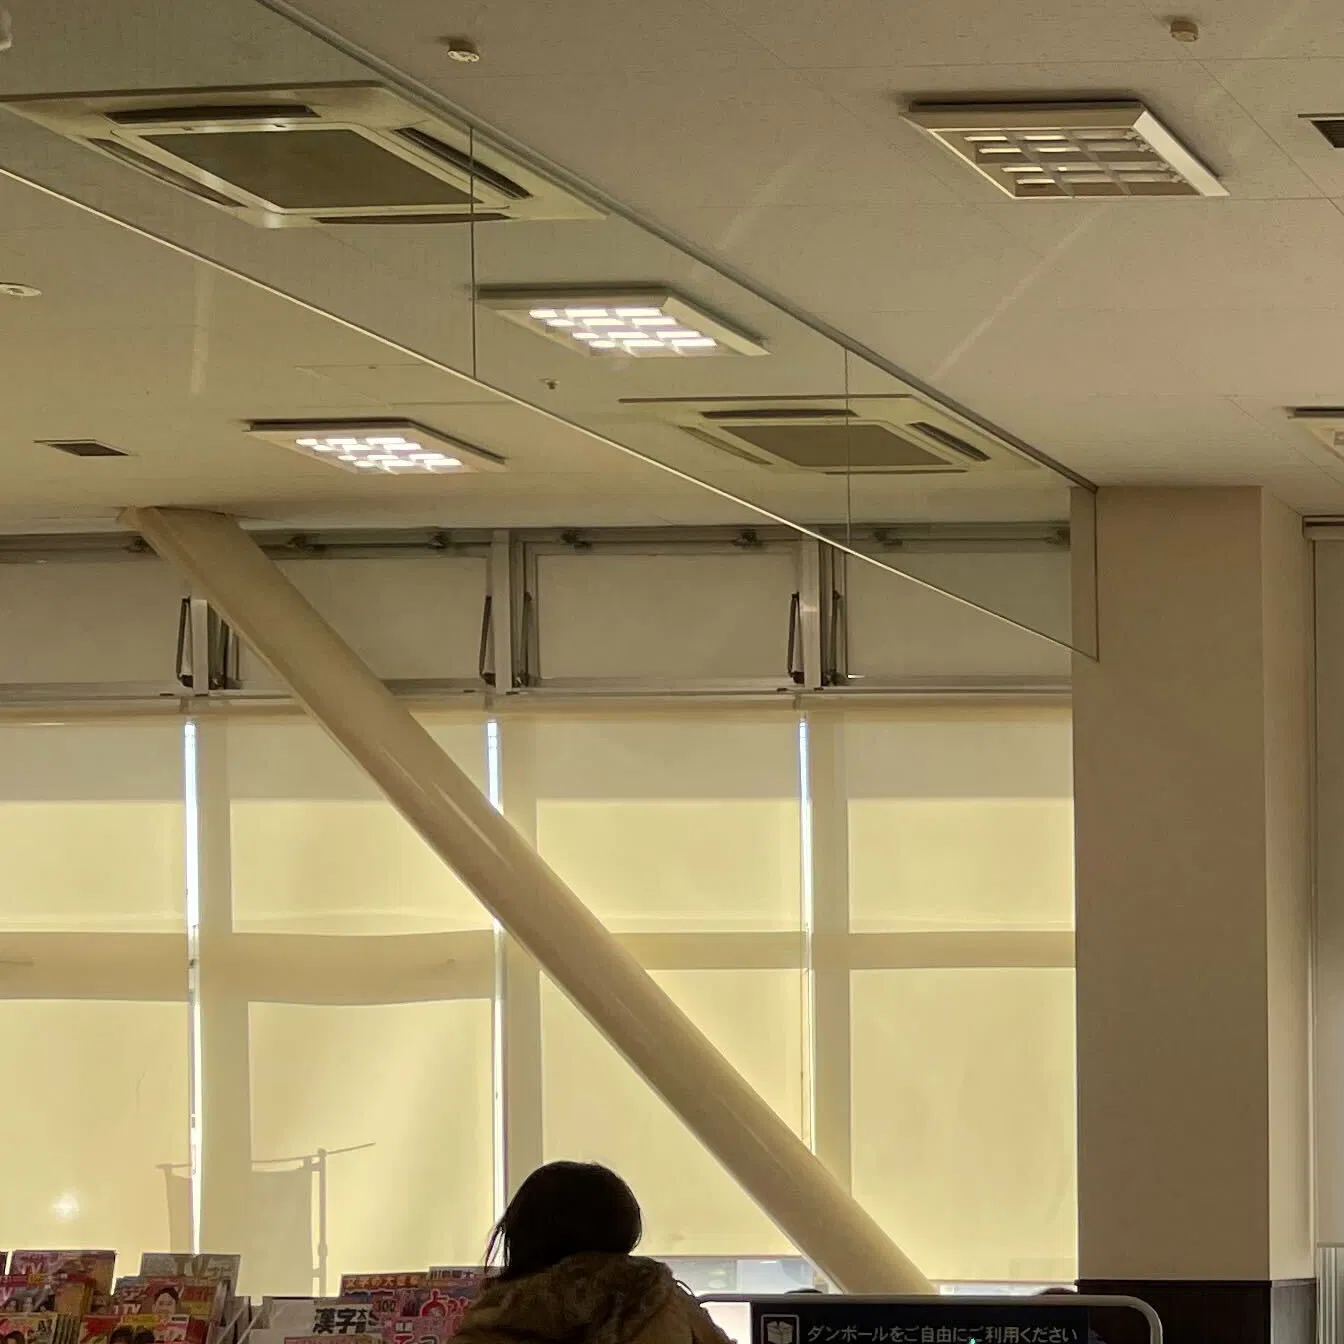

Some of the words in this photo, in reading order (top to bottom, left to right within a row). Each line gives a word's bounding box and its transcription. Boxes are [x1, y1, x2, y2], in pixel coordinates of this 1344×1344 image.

[807, 1324, 1079, 1344] ダンボールをご自由にご利用ください
